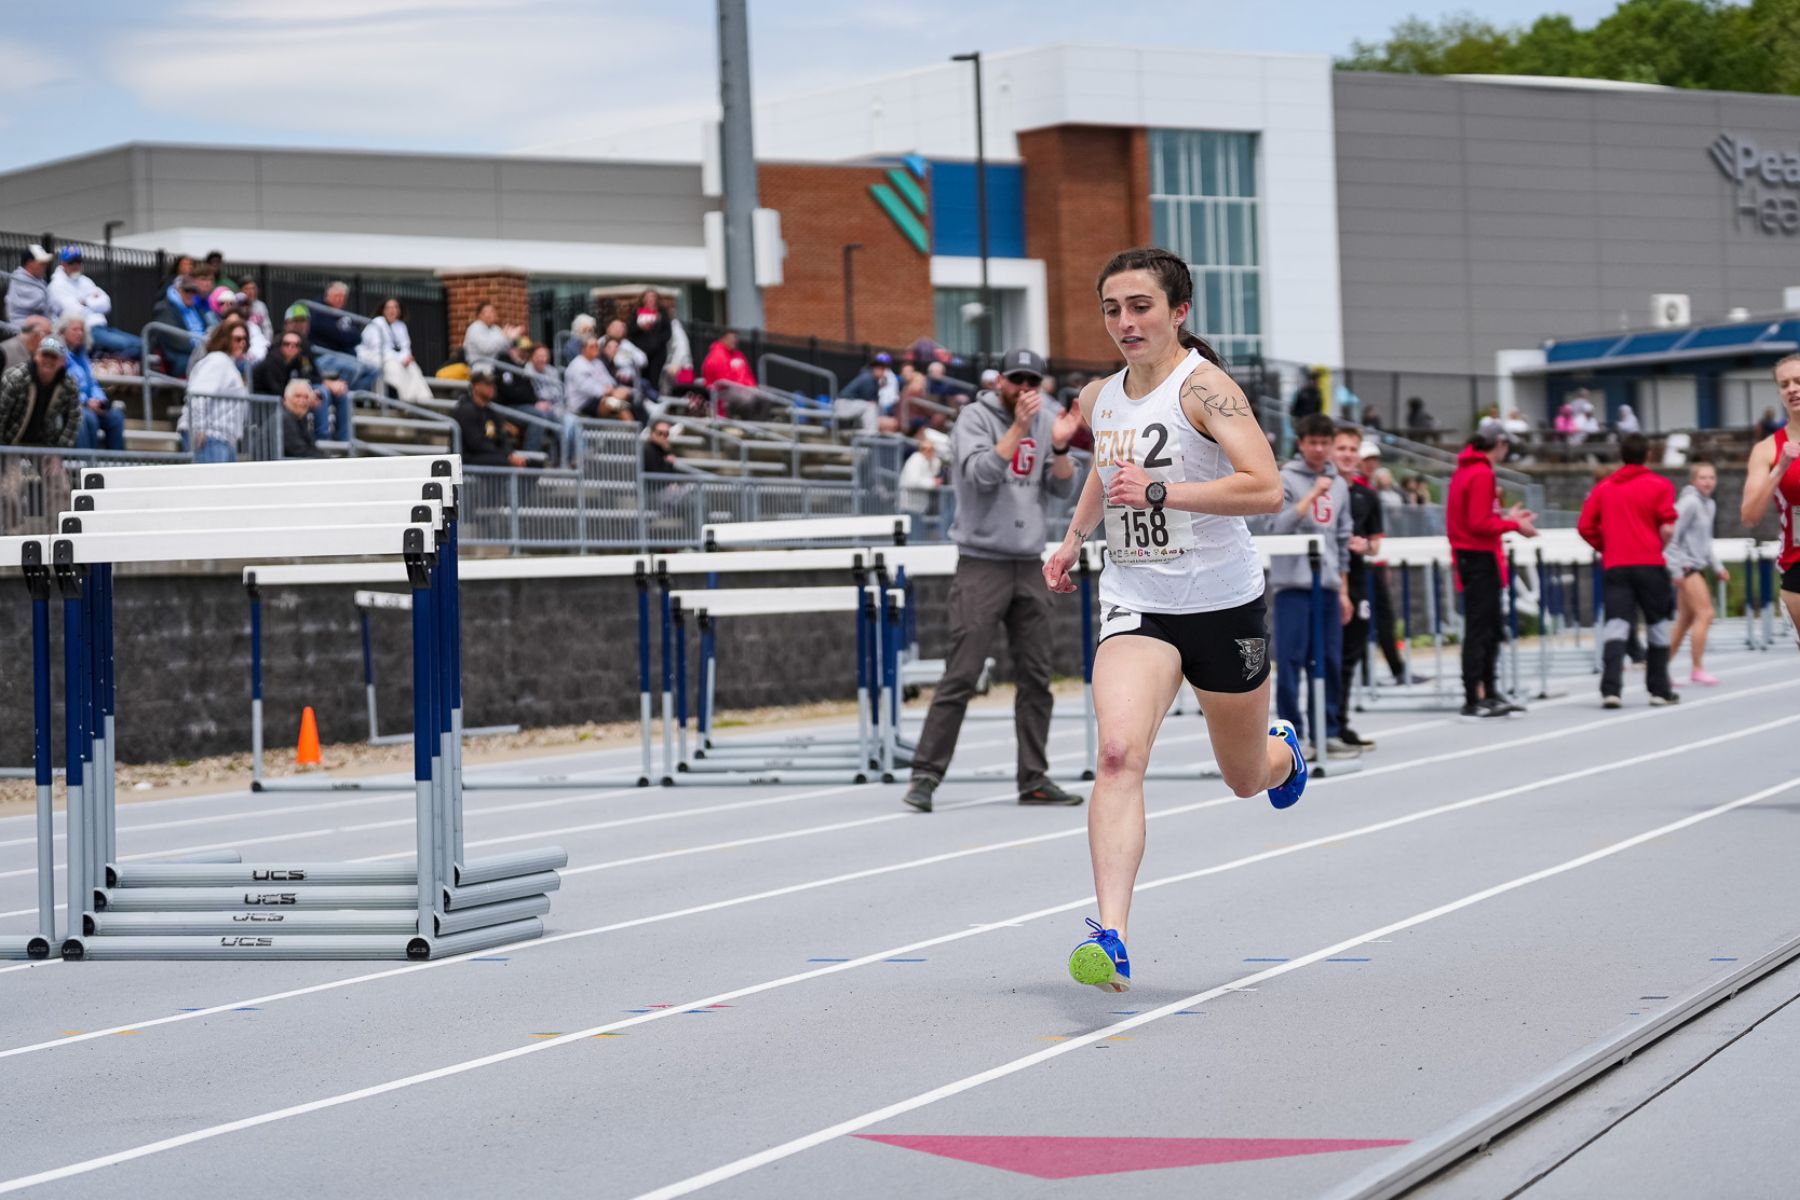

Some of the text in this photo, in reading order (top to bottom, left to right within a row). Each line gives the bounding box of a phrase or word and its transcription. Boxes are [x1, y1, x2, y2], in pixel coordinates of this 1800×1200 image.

[1142, 423, 1172, 468] 2
[1011, 438, 1036, 478] G
[1121, 511, 1169, 547] 158
[252, 869, 305, 881] UCS
[244, 893, 296, 905] UCS
[221, 936, 273, 947] UCS
